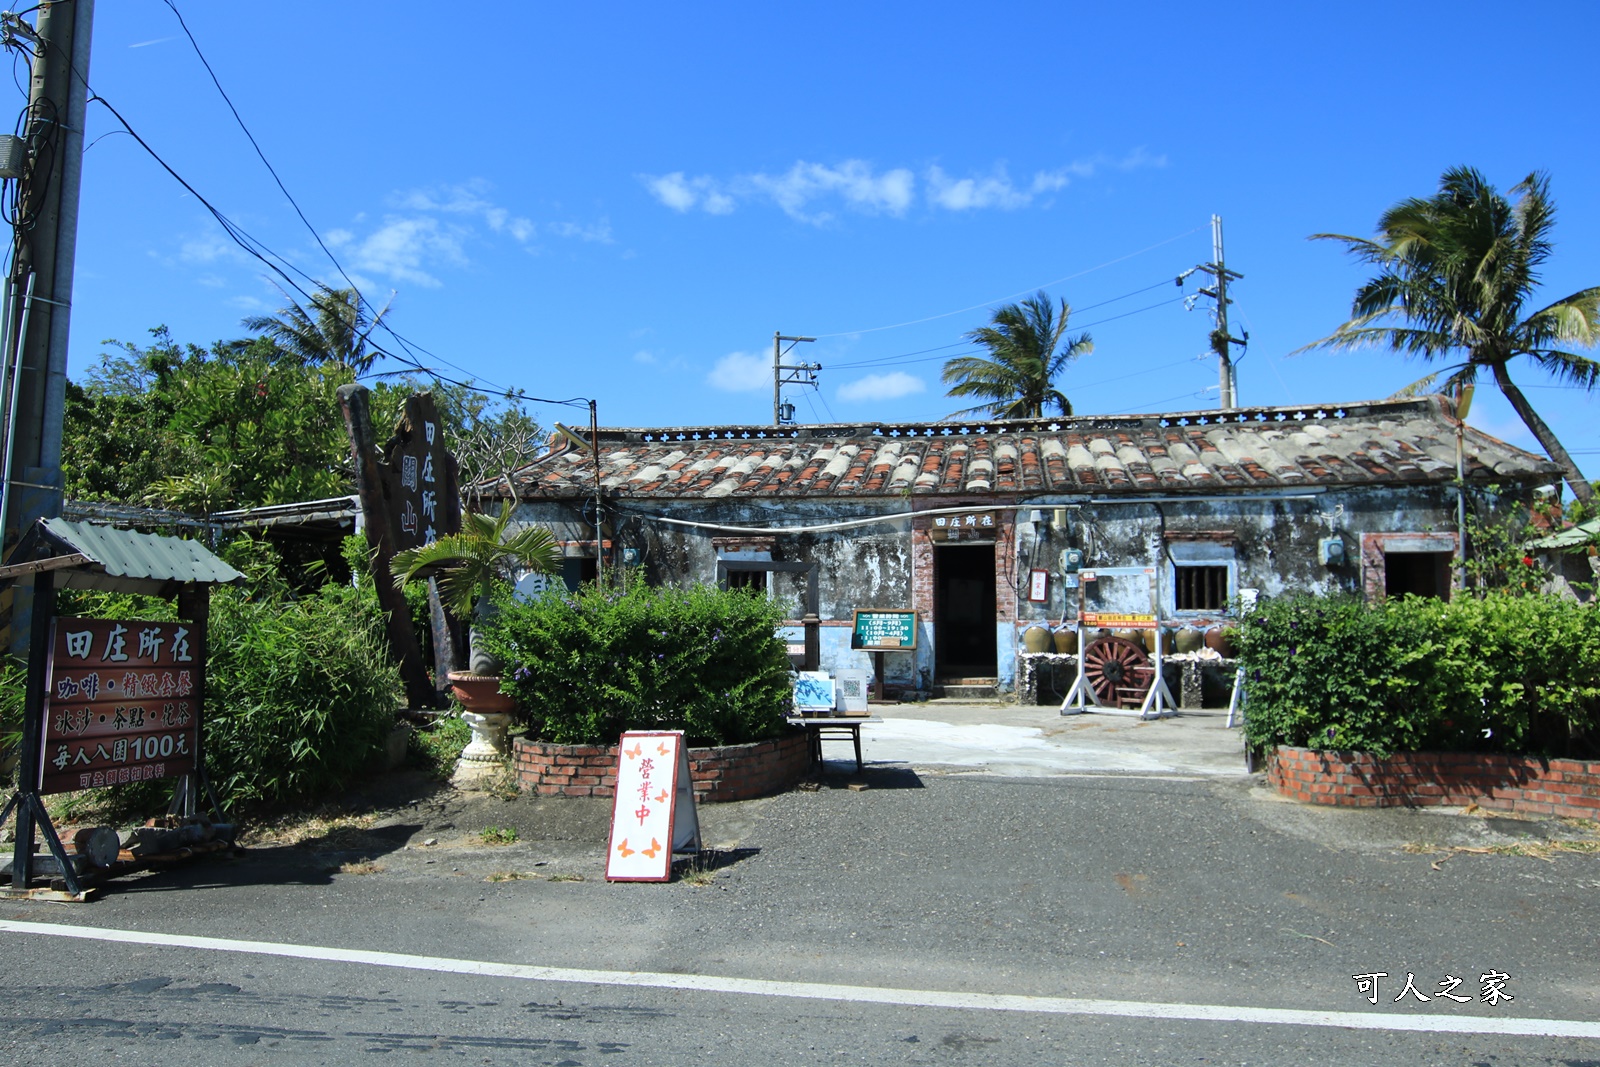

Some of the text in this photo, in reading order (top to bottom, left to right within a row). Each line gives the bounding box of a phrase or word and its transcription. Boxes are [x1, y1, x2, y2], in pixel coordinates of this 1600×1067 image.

[935, 515, 993, 527] 田庄所在
[66, 623, 193, 663] 田庄所在
[635, 758, 655, 827] 營業中
